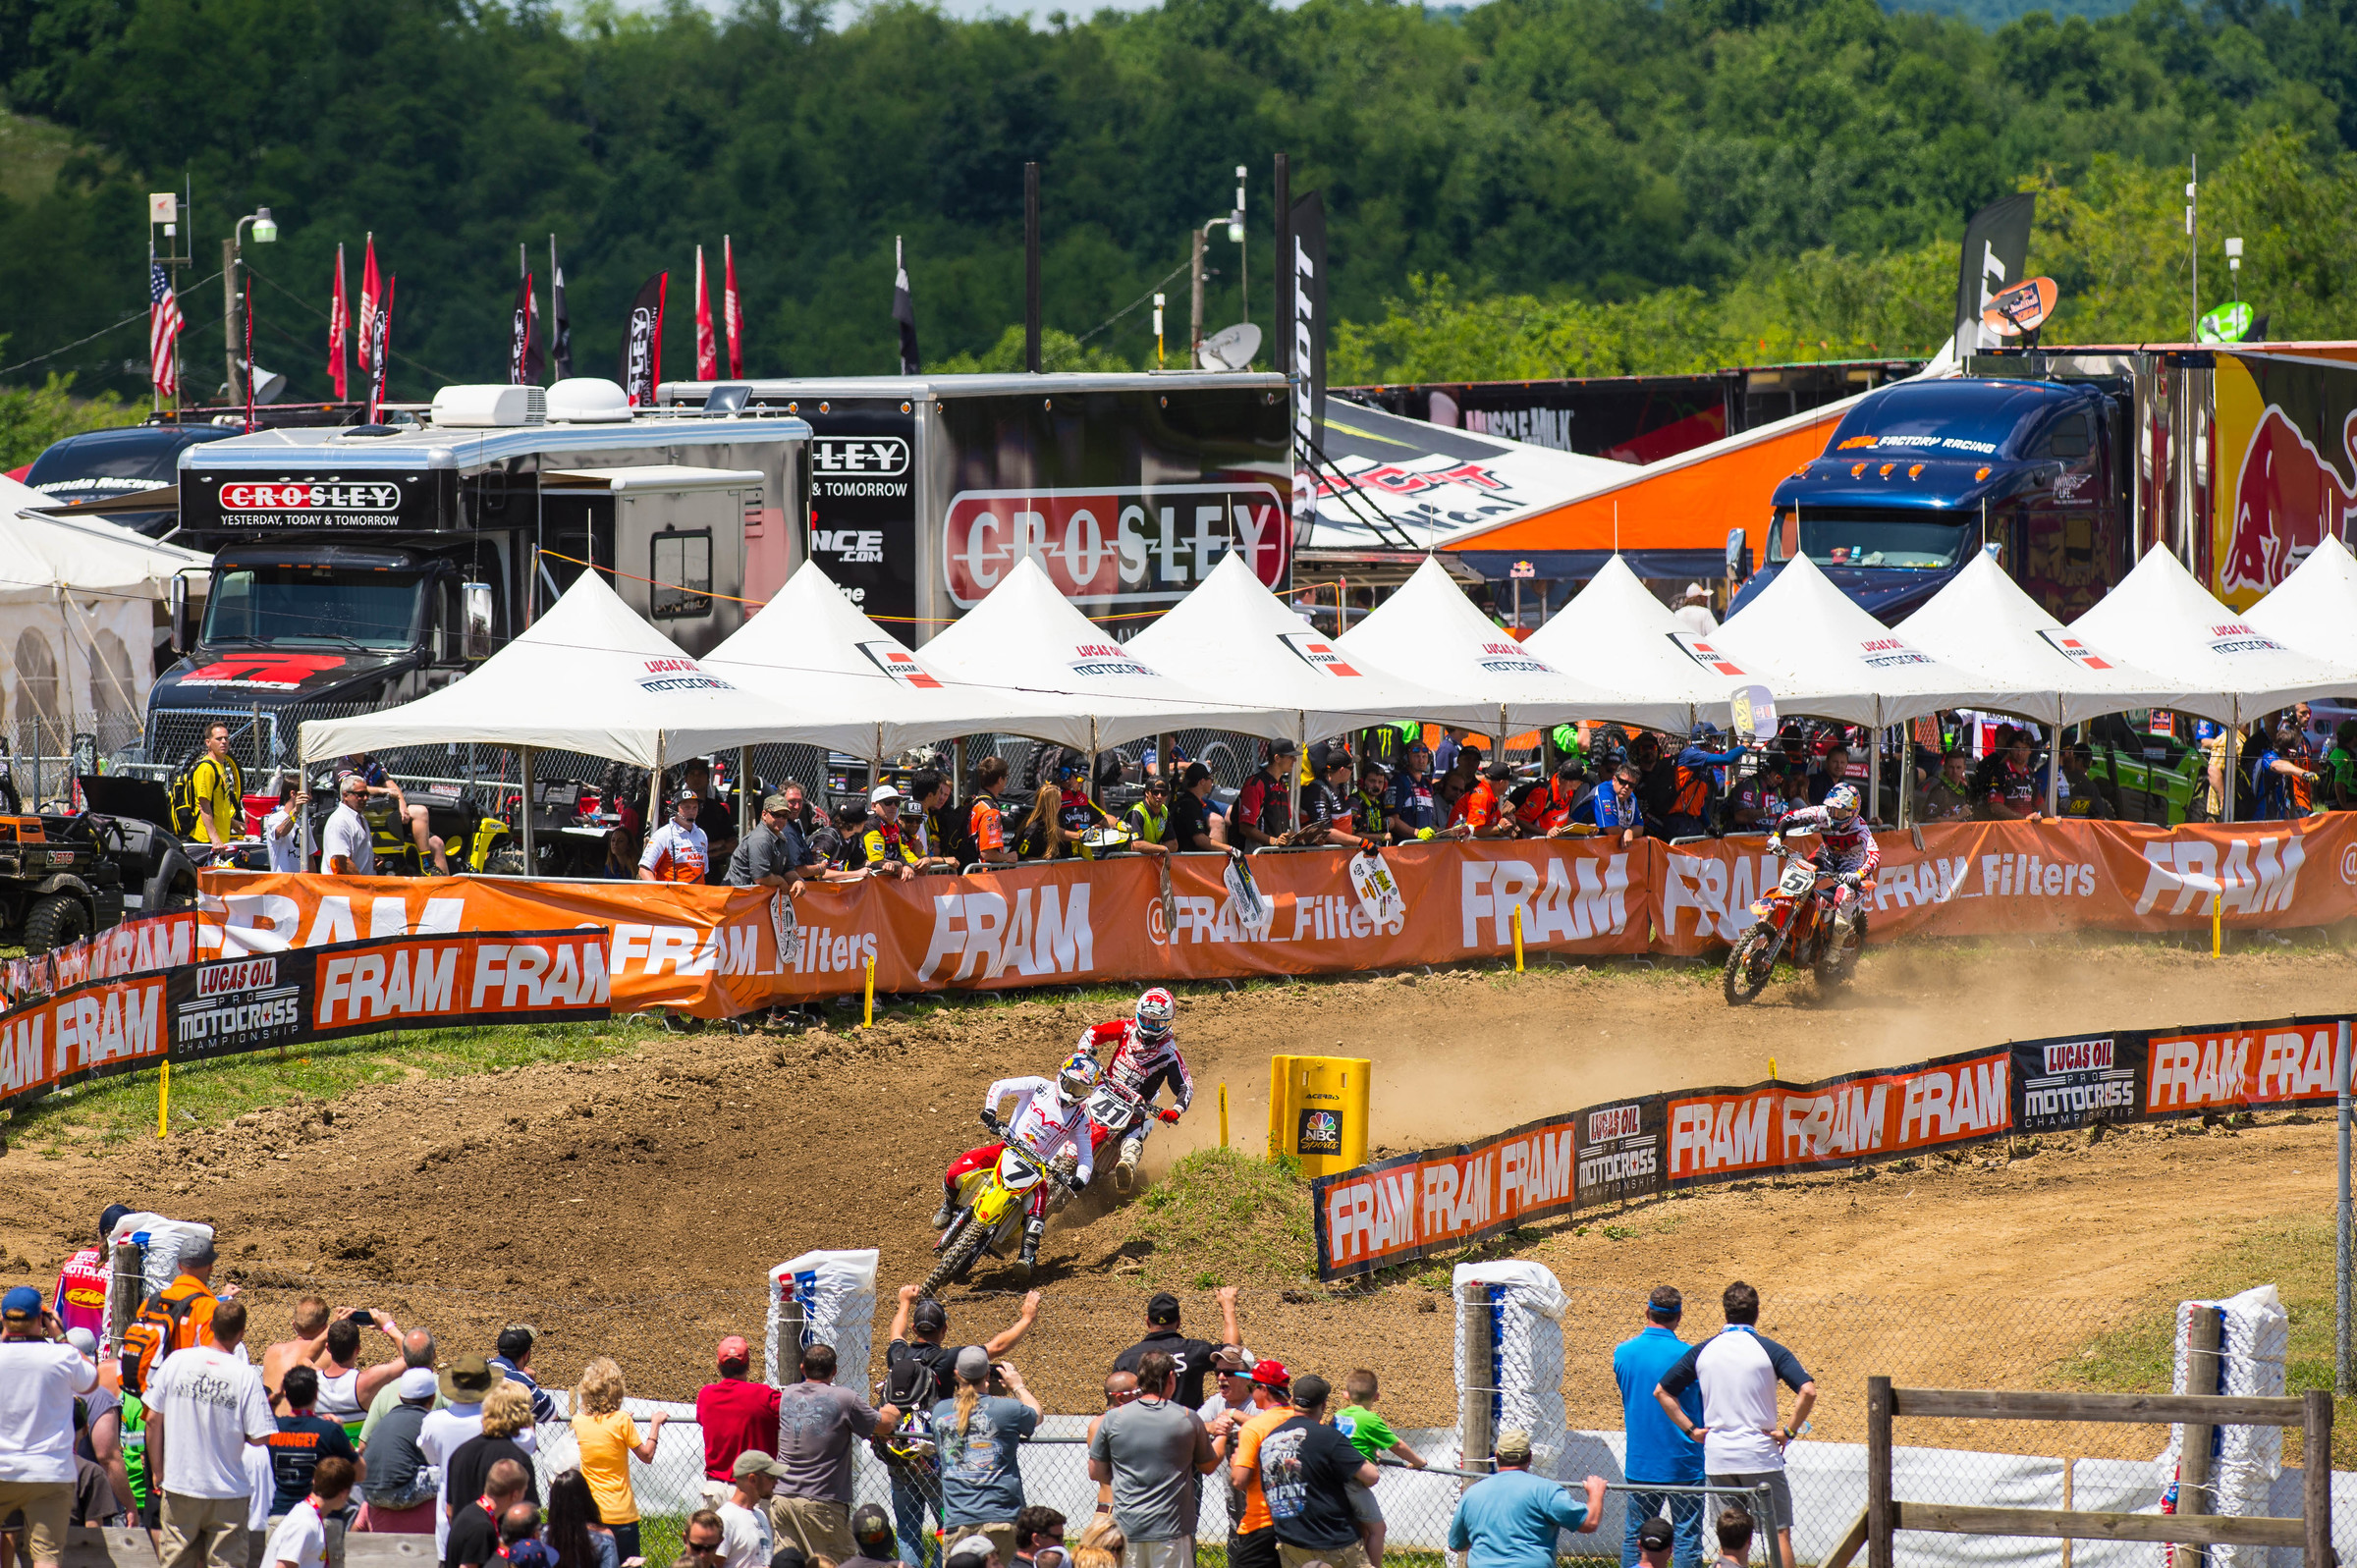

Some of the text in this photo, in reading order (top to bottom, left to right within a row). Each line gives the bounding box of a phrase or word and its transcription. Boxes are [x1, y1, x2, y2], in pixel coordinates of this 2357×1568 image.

[1879, 436, 1942, 447] FACTORY
[1942, 438, 1997, 455] RACING
[231, 486, 393, 507] CROSLEY
[825, 482, 907, 497] TOMORROW
[220, 514, 400, 526] YESTERDAY, TODAY & TOMORROW
[967, 504, 1272, 586] CROSLEY
[839, 551, 883, 563] .COM
[2212, 624, 2241, 636] LUCAS
[1075, 644, 1127, 658] LUCAS OIL
[1482, 643, 1513, 655] LUCAS
[1860, 638, 1904, 652] LUCAS OIL
[2065, 649, 2091, 658] FRAM
[644, 659, 700, 675] LUCAS OIL
[1307, 654, 1340, 663] FRAM
[1695, 653, 1721, 663] FRAM
[886, 664, 920, 675] FRAM
[640, 676, 737, 693] MOTOCROSS
[1781, 872, 1809, 891] 5
[2134, 835, 2306, 916] FRAM
[1461, 852, 1629, 948] FRAM
[918, 882, 1094, 982] FRAM
[108, 920, 191, 977] FRAM
[200, 959, 274, 995] LUCAS OIL
[319, 947, 460, 1024] FRAM
[218, 992, 254, 1005] PRO
[56, 985, 159, 1073] FRAM
[179, 998, 299, 1042] MOTOCROSS
[178, 1024, 299, 1054] CHAMPIONSHIP
[1117, 1054, 1149, 1077] HONDA
[2048, 1041, 2112, 1072] LUCAS OIL
[2067, 1071, 2099, 1085] PRO
[2150, 1035, 2251, 1108] FRAM
[1899, 1060, 2006, 1144] FRAM
[2025, 1081, 2135, 1116] MOTOCROSS
[1091, 1099, 1129, 1127] 41
[1782, 1084, 1888, 1160] FRAM
[1591, 1108, 1638, 1141] LUCAS OIL
[1671, 1097, 1772, 1173] FRAM
[1300, 1136, 1340, 1151] Sports
[1306, 1130, 1337, 1142] NBC
[1603, 1140, 1624, 1153] PRO
[1005, 1160, 1036, 1183] 7
[1579, 1147, 1657, 1189] MOTOCROSS
[1330, 1129, 1571, 1262] FRAM FRAM FRAM
[269, 1432, 321, 1448] DUNGEY
